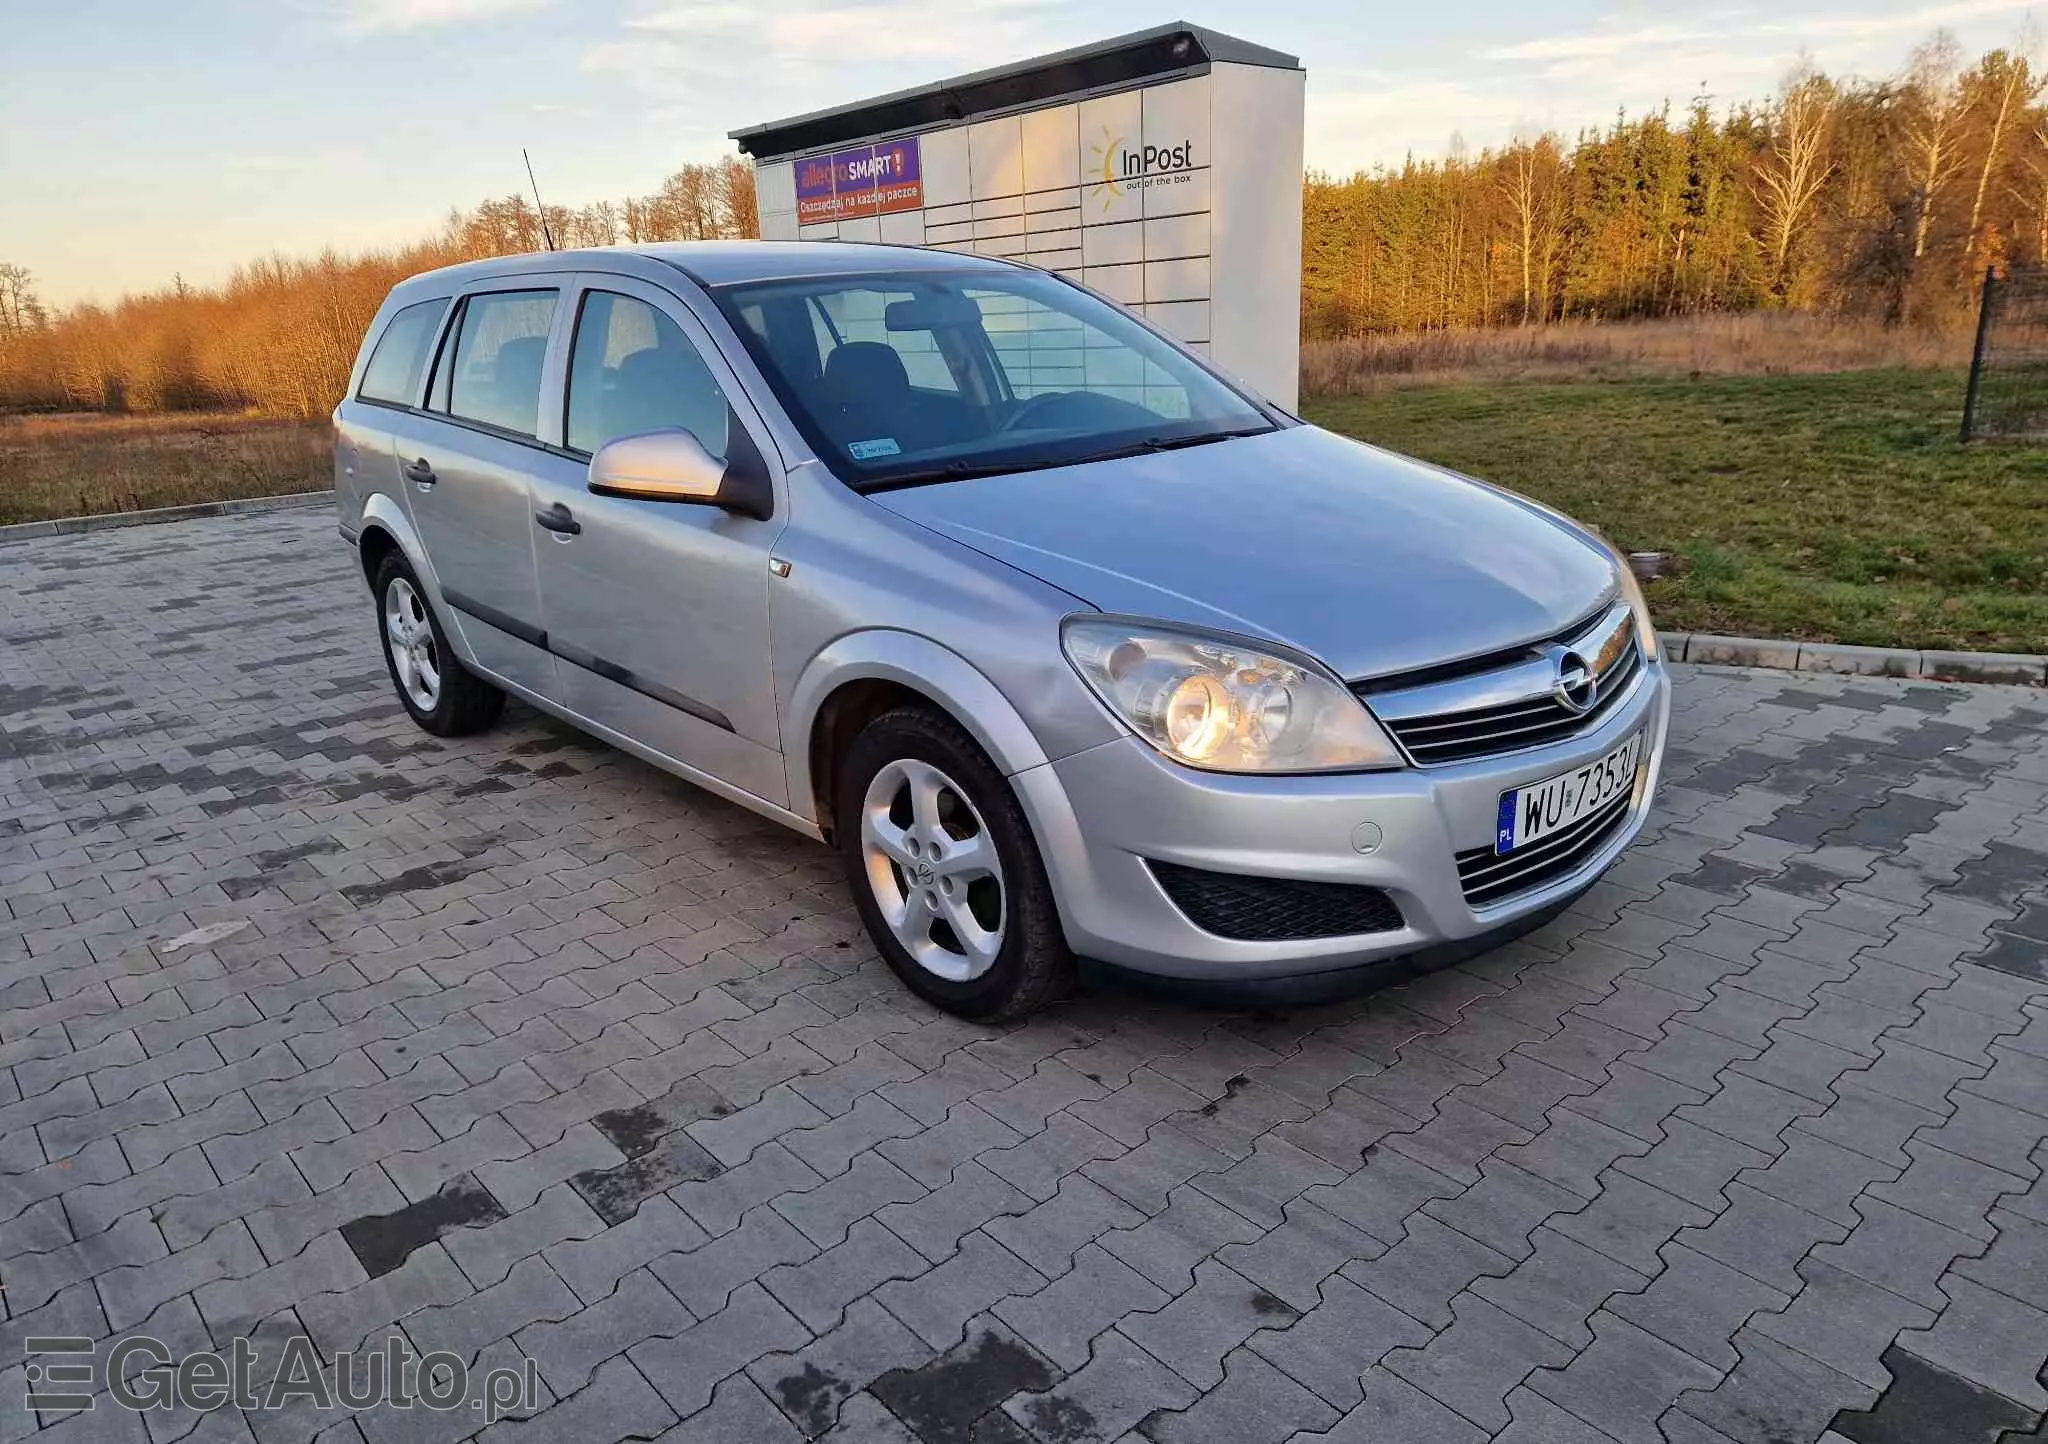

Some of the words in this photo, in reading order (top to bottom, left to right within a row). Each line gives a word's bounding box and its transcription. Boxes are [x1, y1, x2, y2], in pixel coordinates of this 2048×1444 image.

[1123, 140, 1192, 176] InPost
[801, 162, 848, 192] allegro
[1127, 181, 1142, 190] out
[1144, 179, 1154, 188] of
[1156, 177, 1171, 186] the
[1174, 175, 1191, 184] box
[845, 196, 855, 207] na
[887, 186, 918, 202] paczce
[1525, 780, 1566, 838] WU
[1500, 829, 1512, 842] PL
